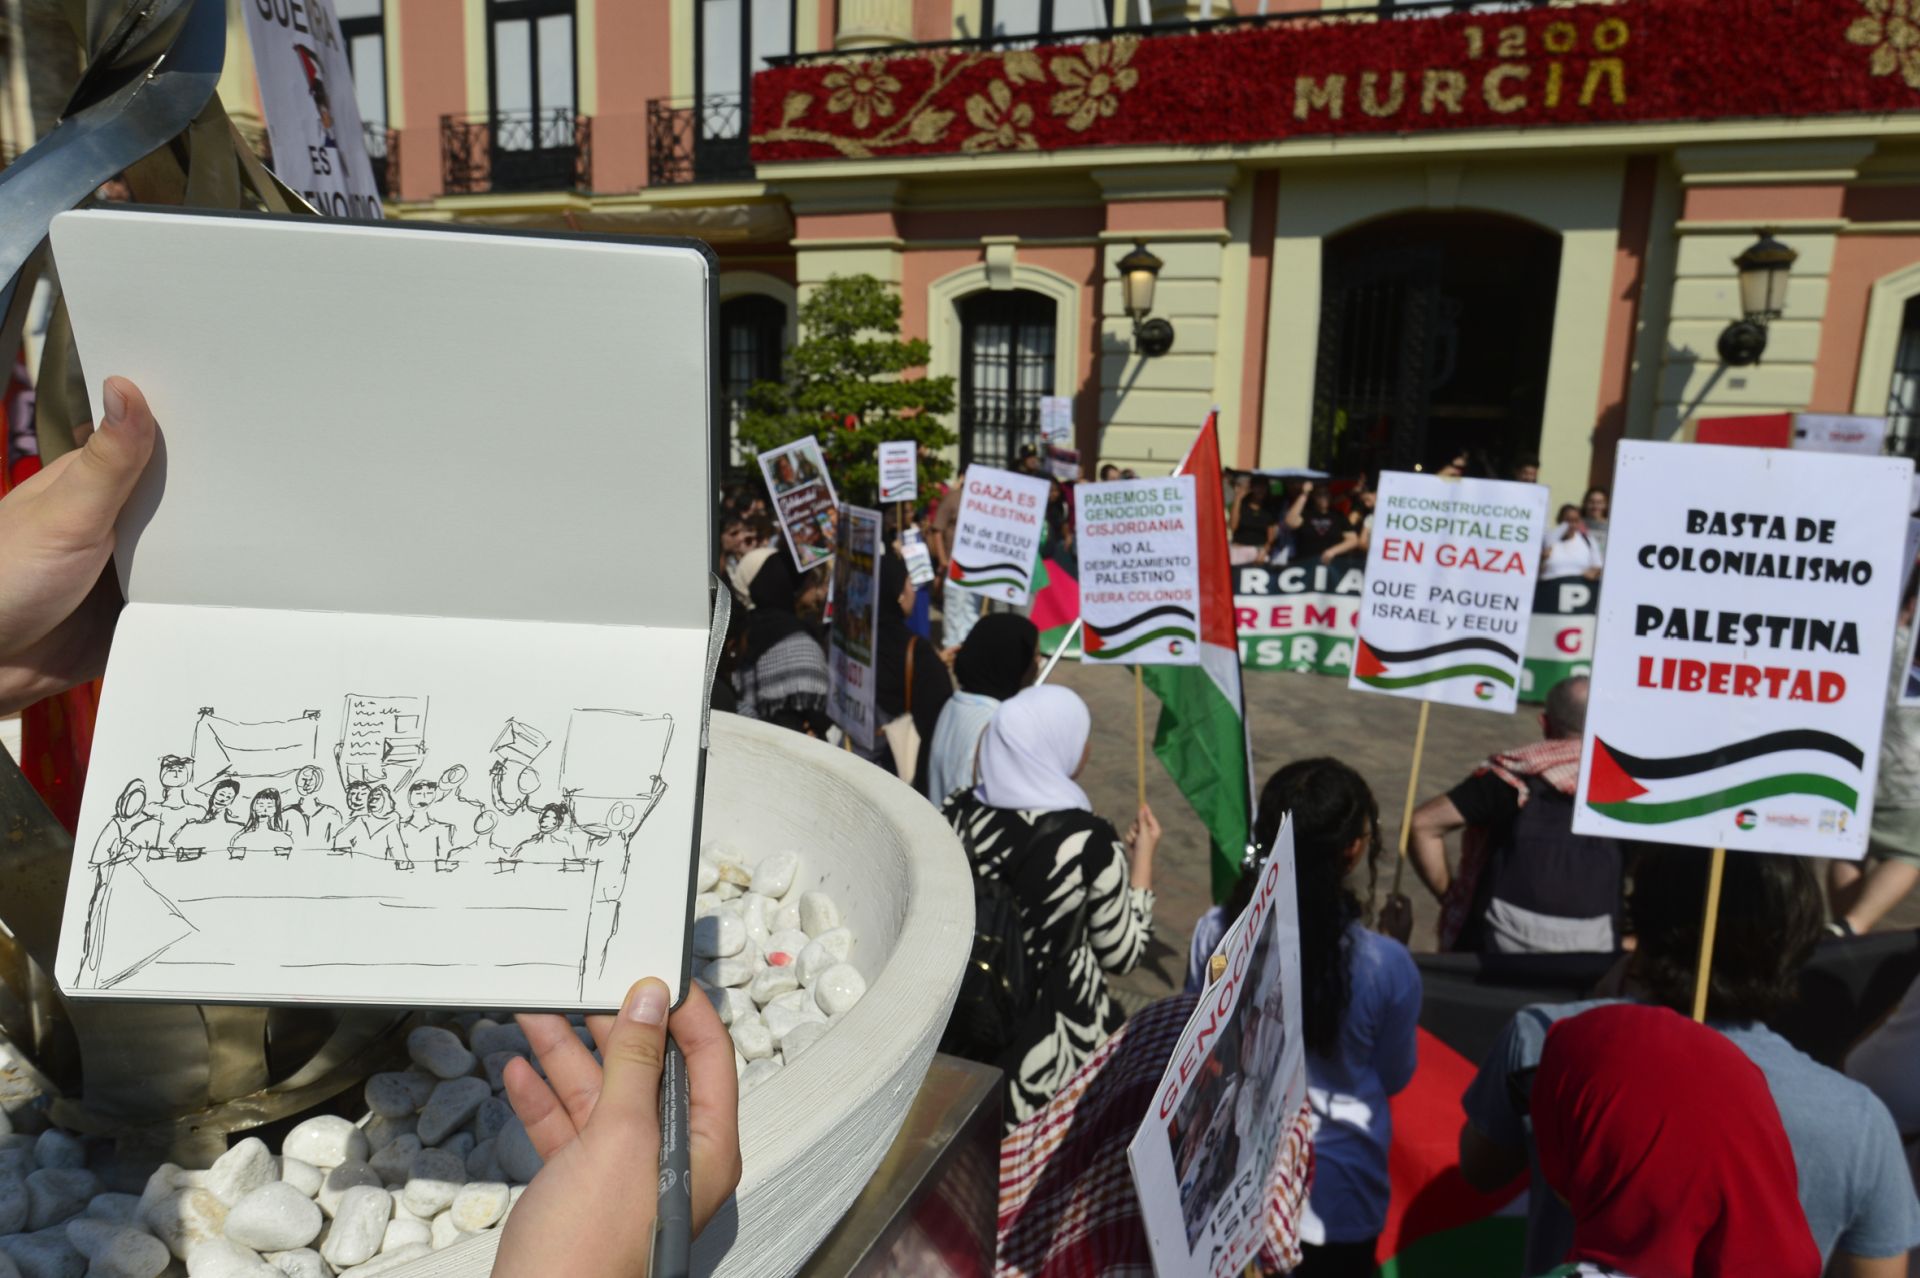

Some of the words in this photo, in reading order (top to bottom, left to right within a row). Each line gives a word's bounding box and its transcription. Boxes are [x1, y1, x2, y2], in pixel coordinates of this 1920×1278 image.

[1464, 18, 1629, 58] 1200
[308, 145, 332, 175] ES
[969, 480, 1013, 502] GAZA
[1017, 492, 1036, 508] ES
[1084, 489, 1158, 507] PAREMOS
[1163, 487, 1183, 500] EL
[1387, 495, 1532, 520] RECONSTRUCCIÓN
[966, 499, 1036, 525] PALESTINA
[1085, 504, 1165, 522] GENOCIDIO
[1169, 504, 1183, 513] EN
[1686, 509, 1787, 541] BASTA
[1795, 517, 1836, 544] DE
[978, 527, 992, 538] de
[996, 531, 1032, 549] EEUU
[1086, 518, 1184, 537] CISJORDANIA
[1385, 514, 1530, 543] HOSPITALES
[988, 543, 1027, 561] ISRAEL
[1111, 542, 1132, 554] NO
[1136, 541, 1155, 553] AL
[1381, 538, 1425, 564] EN
[1435, 543, 1527, 576] GAZA
[1085, 556, 1191, 571] DESPLAZAMIENTO
[1096, 570, 1175, 584] PALESTINO
[1638, 544, 1873, 586] COLONIALISMO
[1085, 592, 1124, 604] FUERA
[1127, 589, 1192, 603] COLONOS
[1240, 565, 1363, 594] RCIA
[1558, 583, 1591, 612] P
[1372, 579, 1417, 600] QUE
[1429, 586, 1519, 612] PAGUEN
[1235, 604, 1358, 629] REM
[1554, 627, 1582, 654] G
[1372, 603, 1440, 625] ISRAEL
[1447, 615, 1458, 630] y
[1463, 614, 1518, 635] EEUU
[1635, 604, 1860, 655] PALESTINA
[1239, 636, 1352, 668] ISRA
[1637, 656, 1846, 704] LIBERTAD
[1159, 862, 1279, 1120] GENOCIDIO
